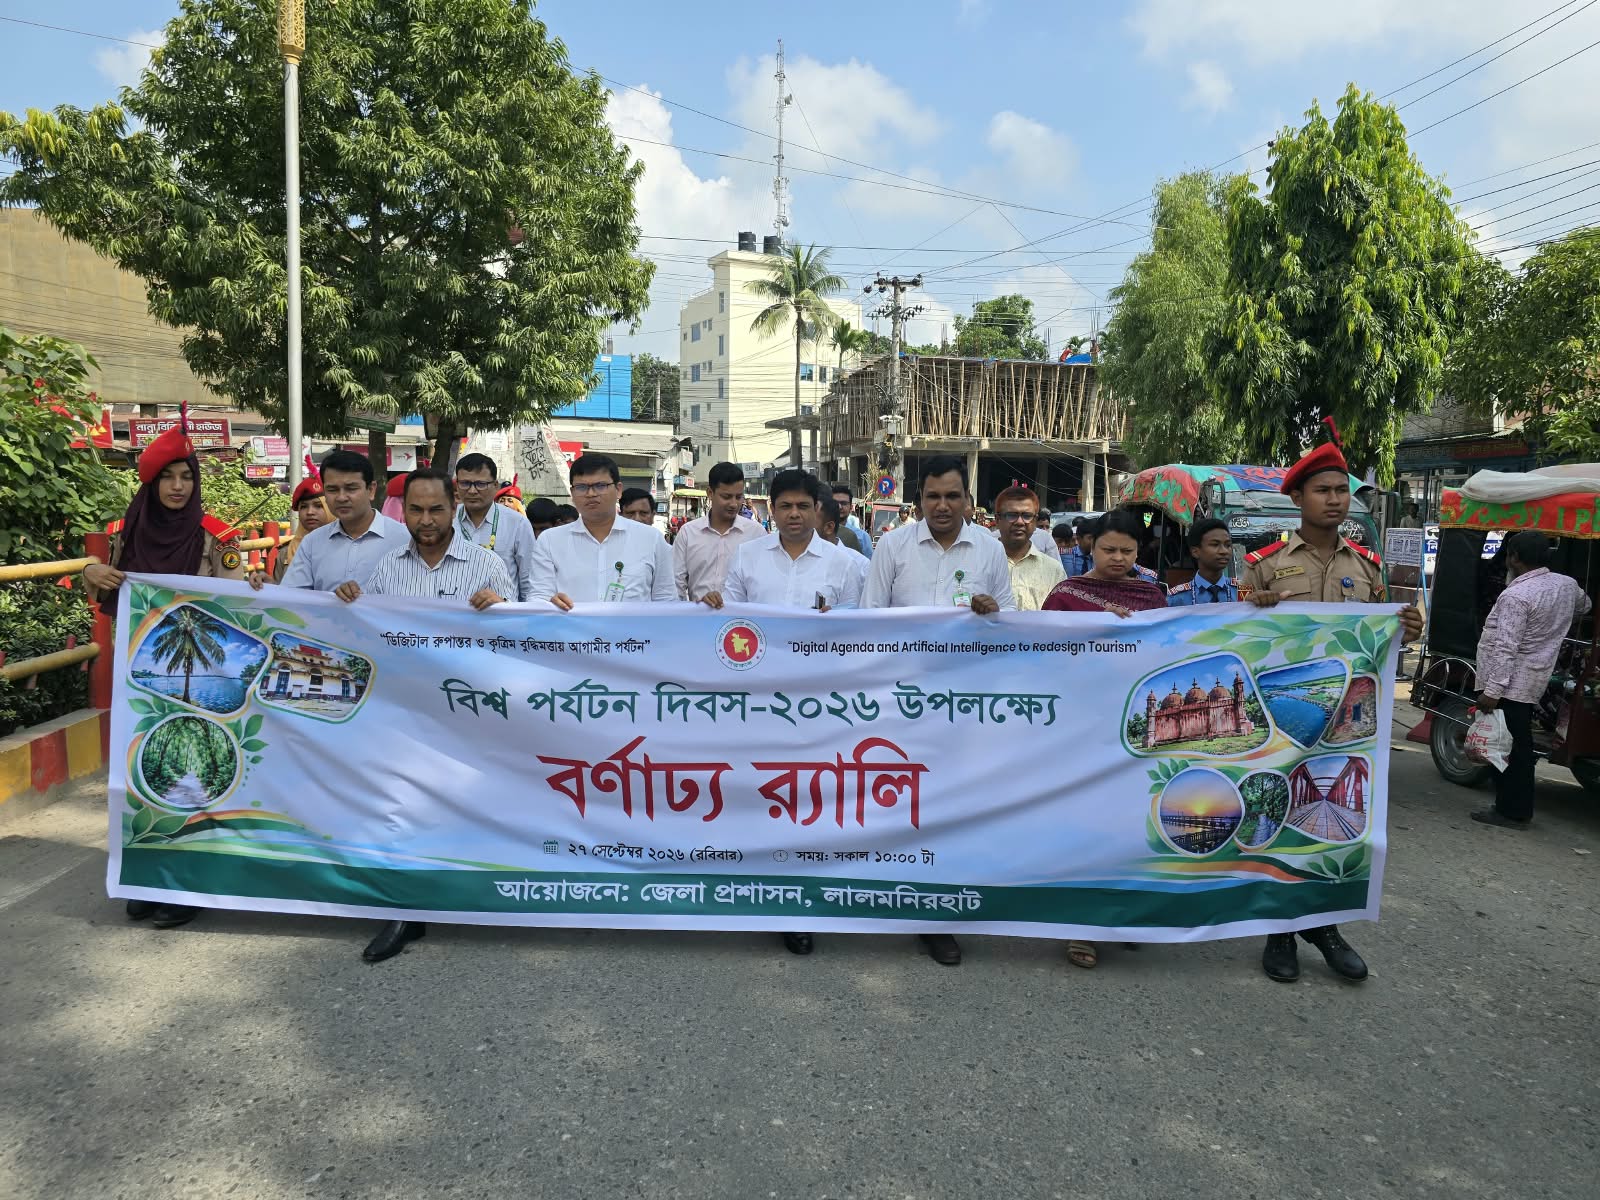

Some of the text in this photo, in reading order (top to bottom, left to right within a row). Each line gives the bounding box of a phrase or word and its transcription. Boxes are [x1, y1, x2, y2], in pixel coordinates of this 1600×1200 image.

[380, 632, 429, 648] “ডিজিটাল
[476, 638, 485, 647] ও
[488, 636, 516, 653] কৃত্রিম
[520, 637, 565, 653] বুদ্ধিমত্তায়
[569, 637, 611, 654] আগামীর
[615, 638, 650, 653] পর্যটন”
[787, 640, 1141, 656] “Digital Agenda and Artificial Intelligence to Redesign Tourism”
[440, 679, 1061, 726] বিশ্ব পর্যটন দিবস-২০২৬ উপলক্ষ্যে
[536, 736, 734, 822] বর্ণাঢ্য
[568, 842, 743, 863] ২৭ সেপ্টেম্বর ২০২৬ (রবিবার)
[795, 848, 935, 866] সময়: সকাল ১০:০০ টা
[494, 878, 984, 913] আয়োজনে: জেলা প্রশাসন, লালমনিরহাট
